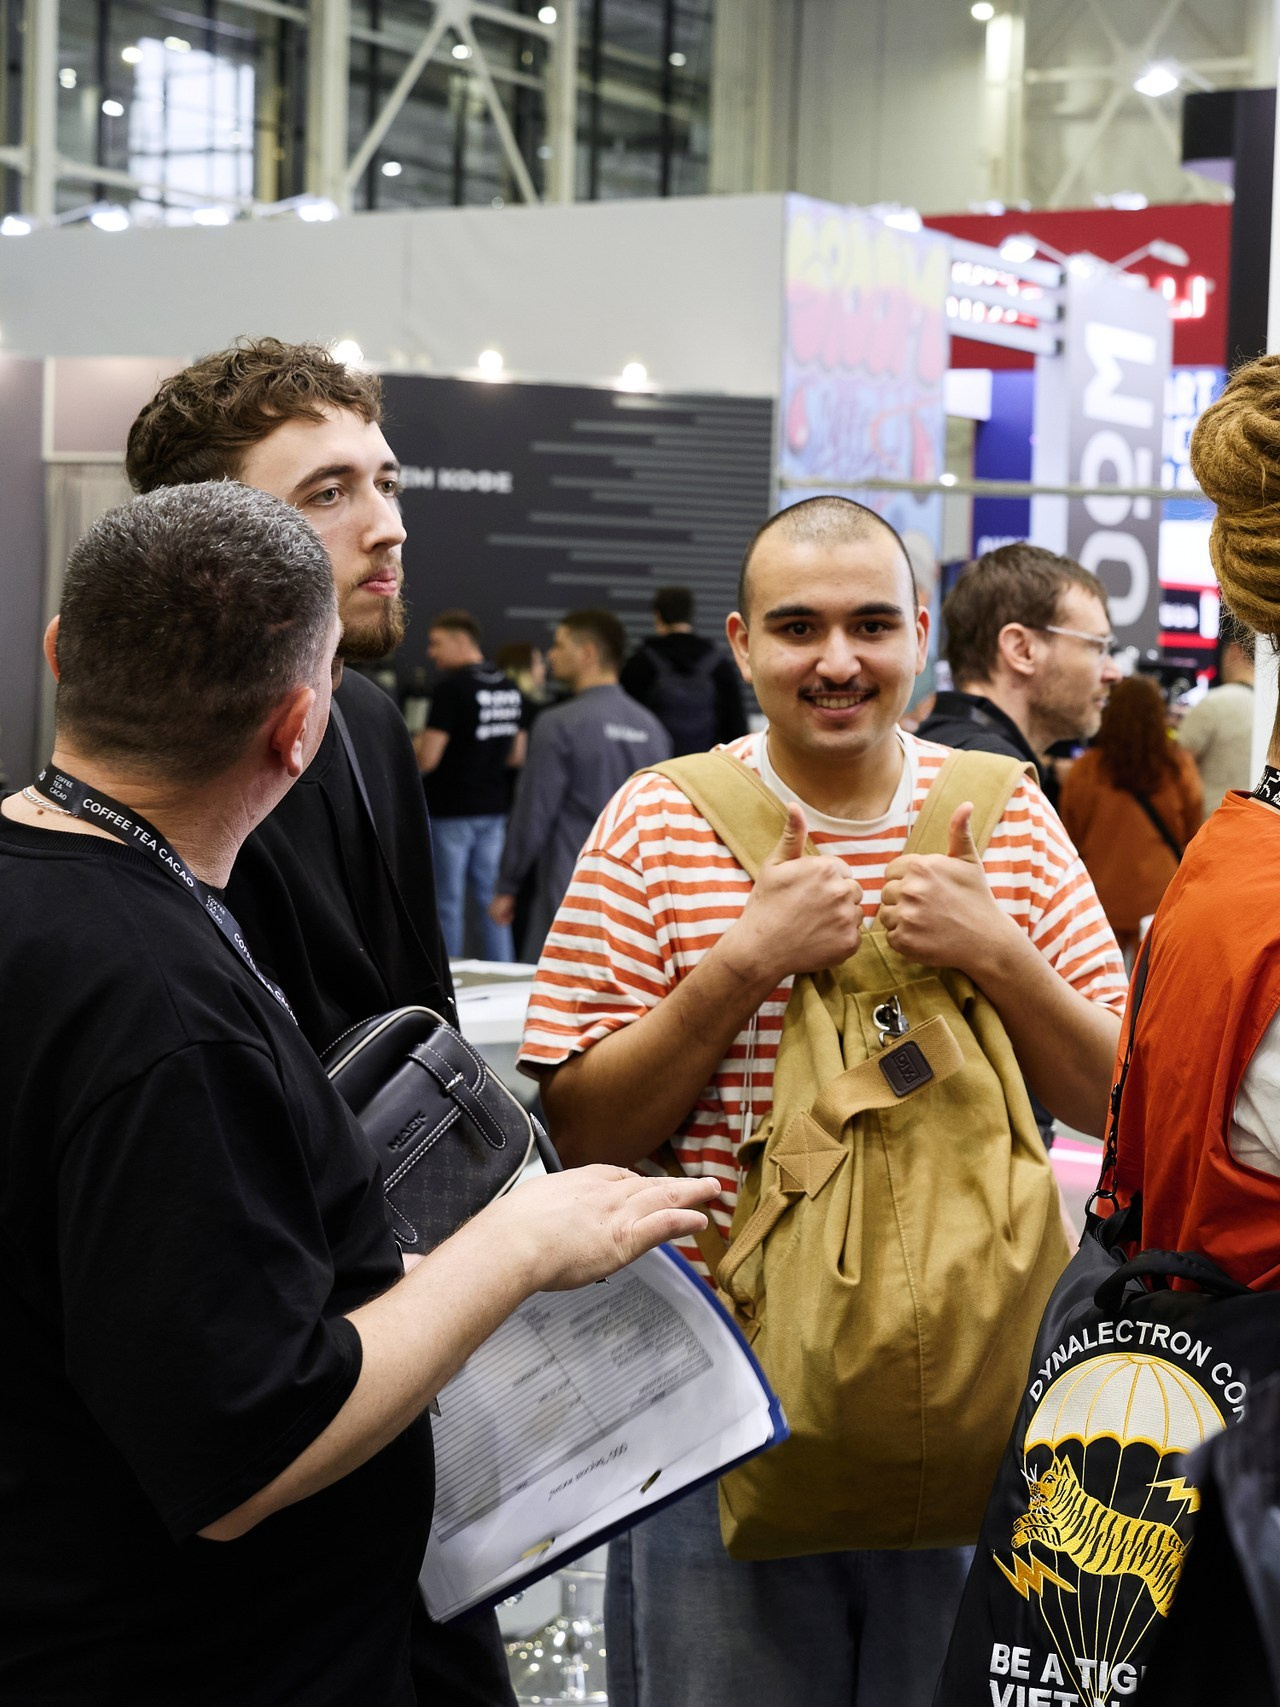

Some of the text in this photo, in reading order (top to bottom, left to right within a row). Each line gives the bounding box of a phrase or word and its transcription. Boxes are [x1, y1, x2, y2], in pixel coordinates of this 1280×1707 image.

[49, 787, 67, 801] CACAO
[52, 781, 63, 790] TEA
[55, 774, 74, 789] COFFEE
[82, 798, 194, 888] COFFEE TEA CACAO
[1028, 1319, 1213, 1402] DYNALECTRON
[989, 1642, 1148, 1696] BE A TIG
